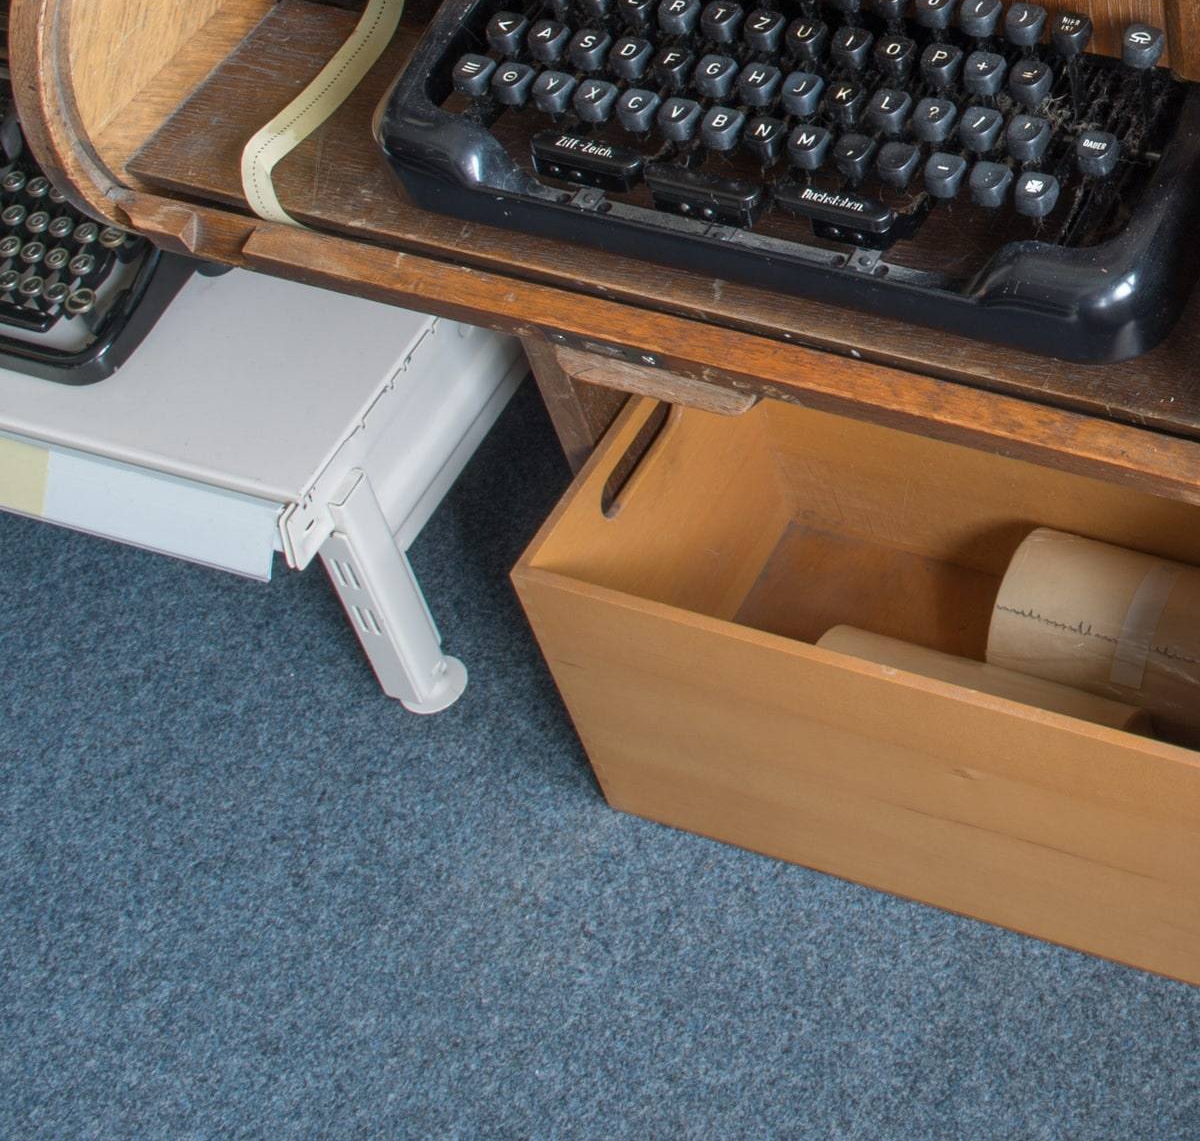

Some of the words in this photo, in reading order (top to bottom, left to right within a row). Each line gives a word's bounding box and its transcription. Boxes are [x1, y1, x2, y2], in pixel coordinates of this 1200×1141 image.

[669, 0, 686, 12] R
[712, 9, 726, 20] T
[753, 16, 771, 29] Z
[796, 25, 813, 38] U
[845, 35, 854, 47] I
[886, 43, 901, 55] O
[931, 50, 948, 62] P
[536, 27, 552, 39] A
[579, 35, 596, 48] S
[620, 43, 637, 56] D
[663, 52, 681, 64] F
[706, 62, 721, 75] G
[748, 70, 766, 84] H
[792, 81, 807, 93] J
[835, 87, 852, 100] K
[880, 96, 890, 110] L
[546, 77, 559, 90] Y
[584, 86, 601, 99] X
[627, 96, 643, 109] C
[671, 105, 684, 118] V
[711, 113, 728, 127] B
[754, 123, 772, 137] N
[796, 132, 816, 147] M
[555, 135, 613, 158] Ziff.-Zeich.
[1082, 139, 1107, 151] DAUER
